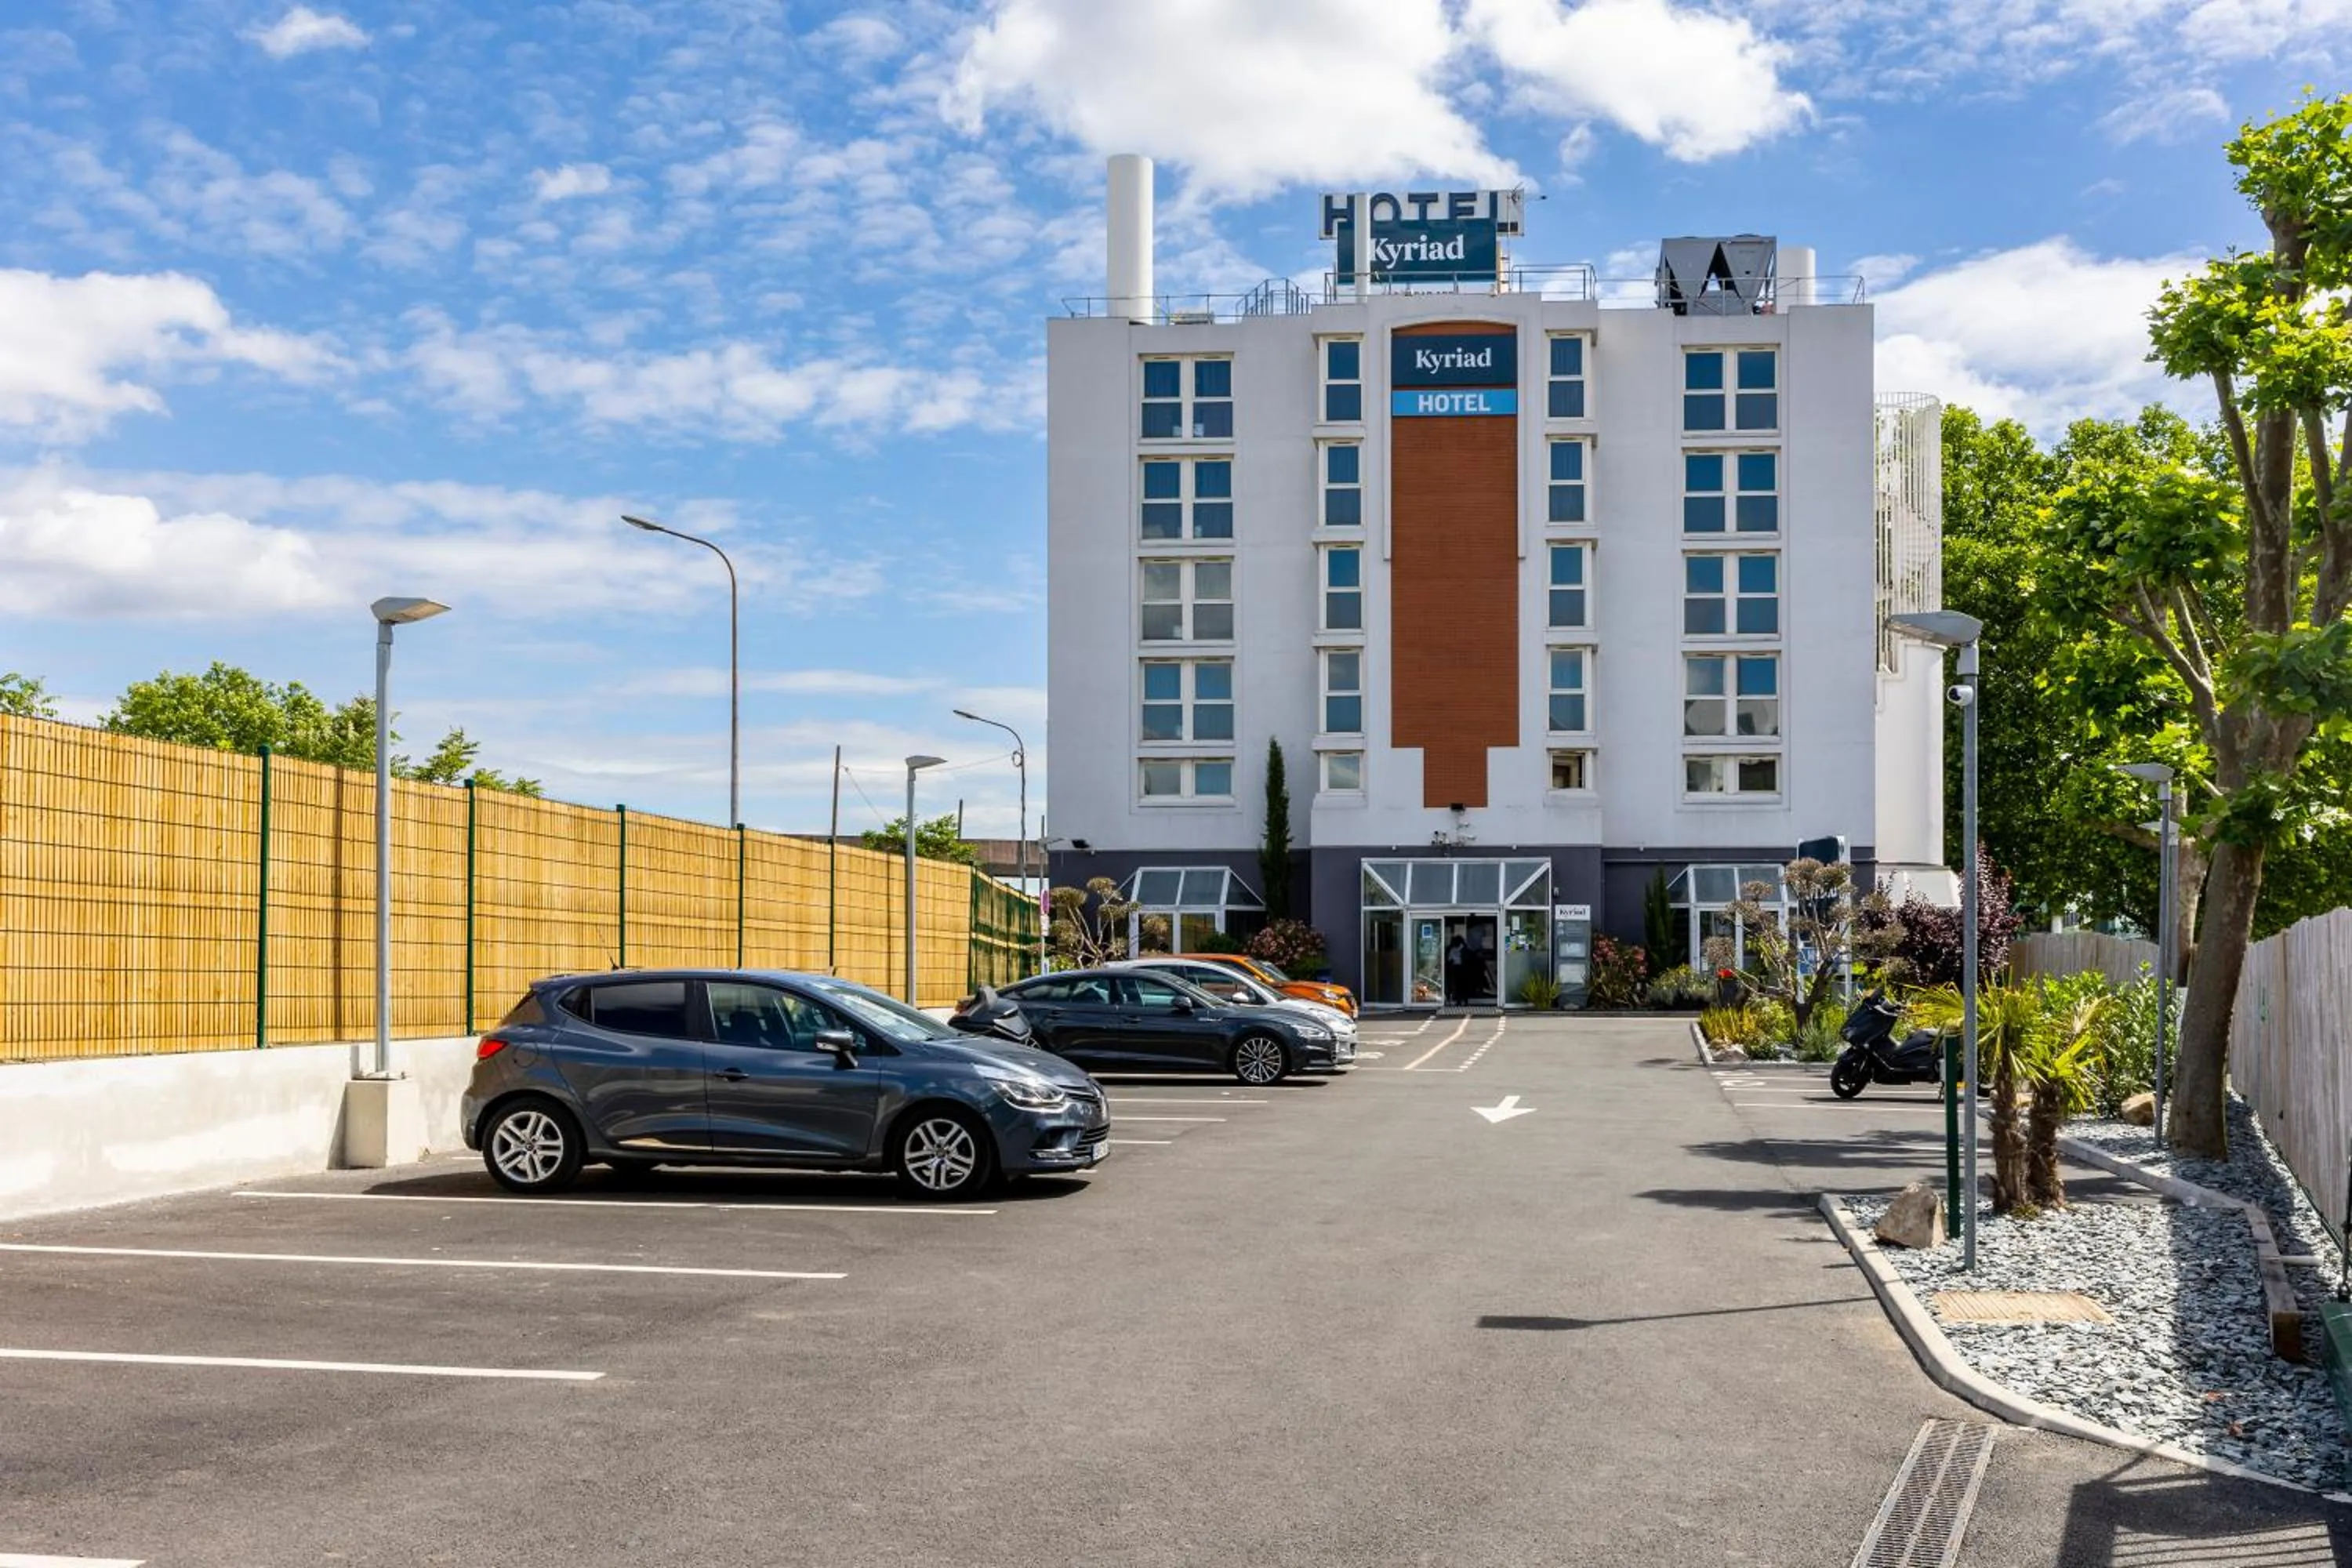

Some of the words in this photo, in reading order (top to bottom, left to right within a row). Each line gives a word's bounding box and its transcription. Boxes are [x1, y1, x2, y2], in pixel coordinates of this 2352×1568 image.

[1371, 234, 1465, 270] Kyriad
[1415, 347, 1492, 374] Kyriad
[1417, 394, 1491, 412] HOTEL
